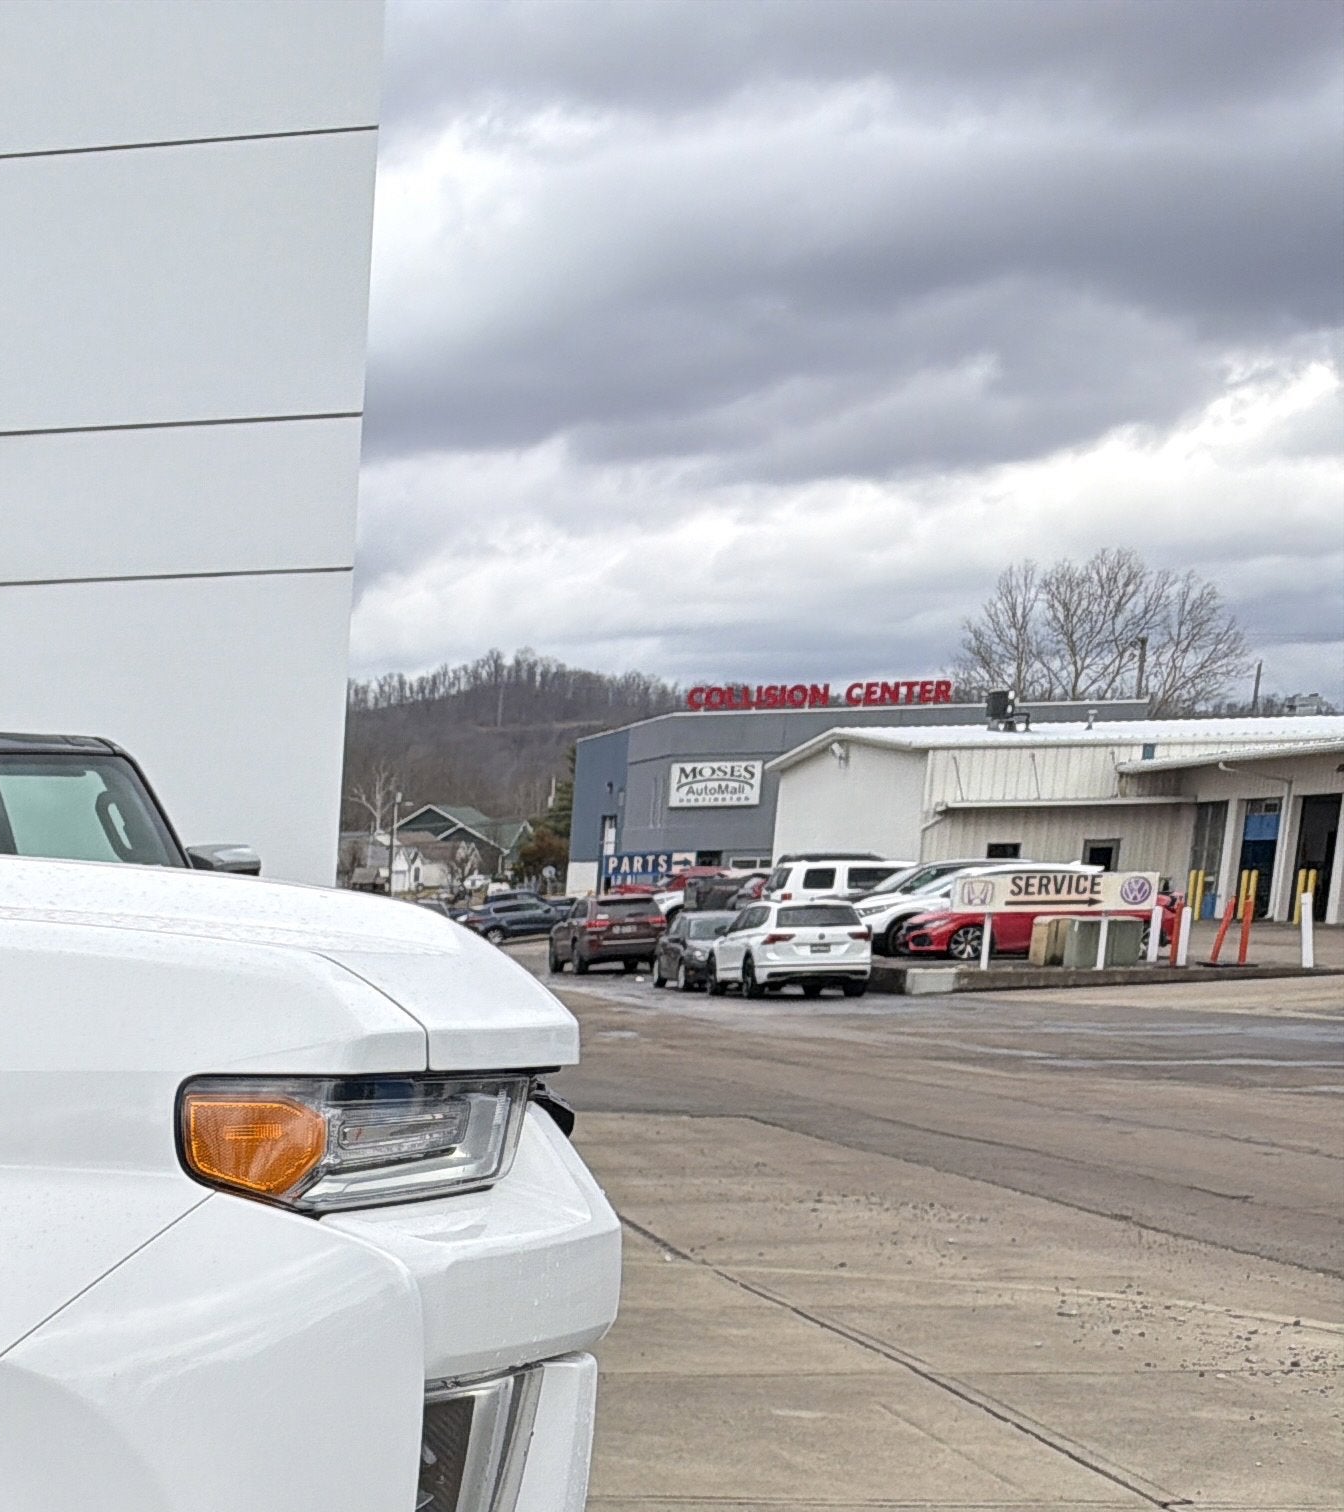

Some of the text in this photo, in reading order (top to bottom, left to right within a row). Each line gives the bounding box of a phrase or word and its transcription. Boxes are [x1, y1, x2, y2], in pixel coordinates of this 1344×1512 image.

[687, 680, 953, 711] COLLISION CENTER
[676, 764, 755, 784] MOSES
[686, 784, 745, 796] AutoMall
[608, 855, 668, 874] PARTS
[1010, 874, 1103, 896] SERVICE
